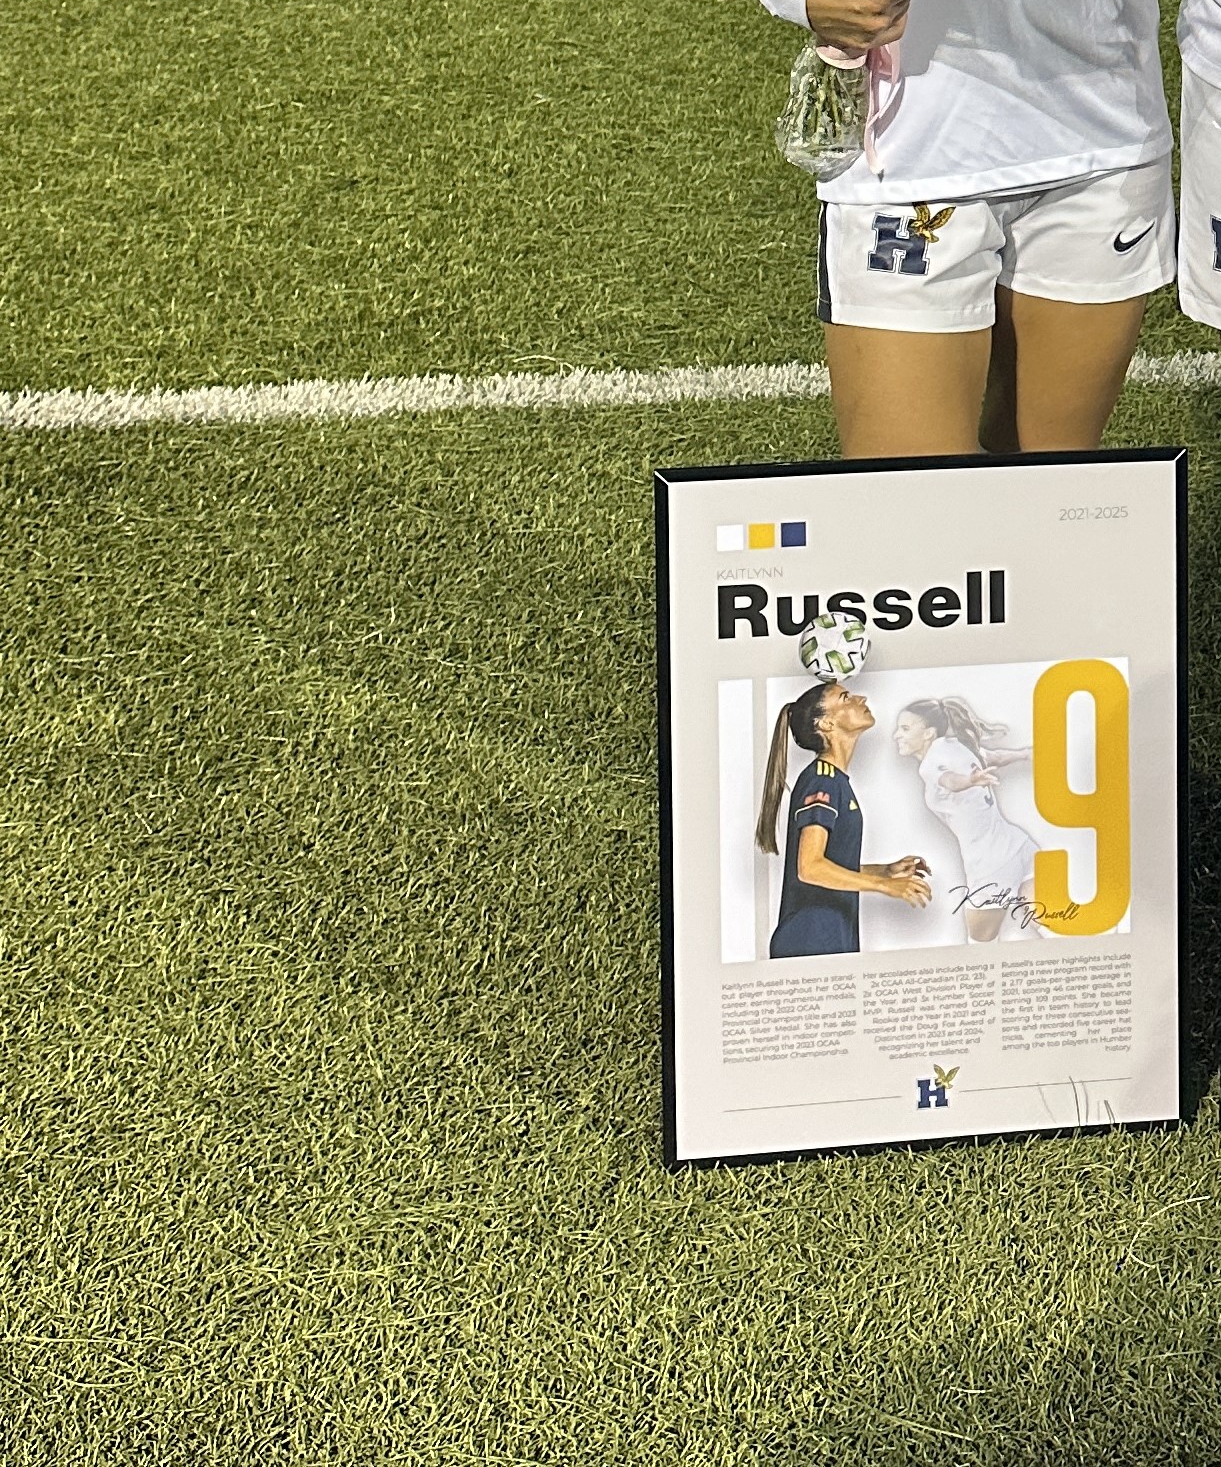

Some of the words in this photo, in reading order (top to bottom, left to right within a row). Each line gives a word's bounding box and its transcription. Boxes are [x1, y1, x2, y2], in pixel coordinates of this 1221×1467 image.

[1058, 506, 1129, 522] 2021-2025
[716, 565, 784, 581] KAITLYNN
[716, 569, 1007, 641] Russell
[1032, 658, 1130, 937] 9
